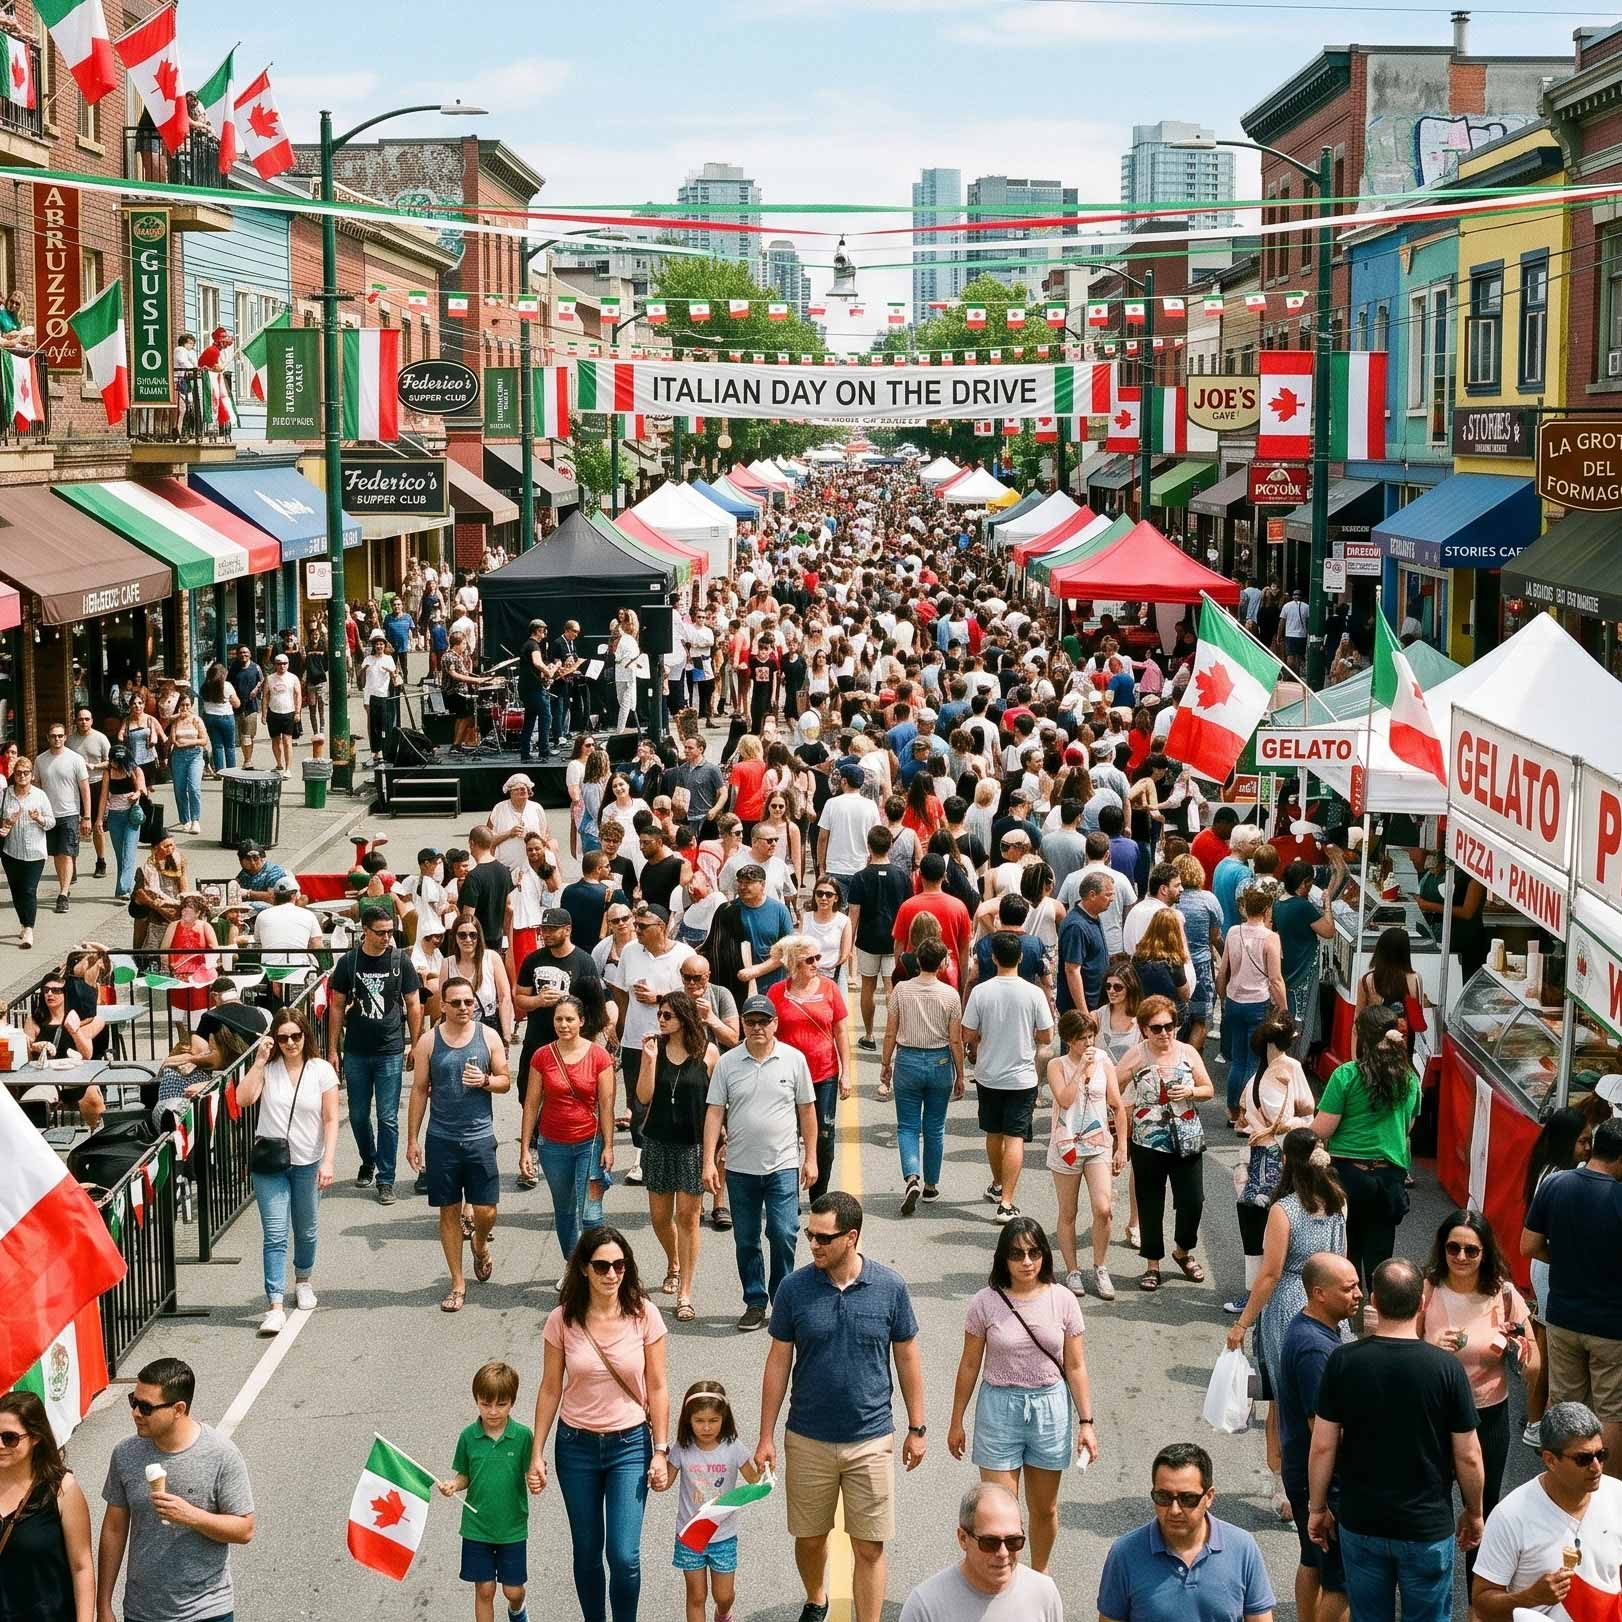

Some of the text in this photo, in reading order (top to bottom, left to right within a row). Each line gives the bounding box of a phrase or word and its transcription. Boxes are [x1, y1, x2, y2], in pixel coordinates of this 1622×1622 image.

[44, 187, 68, 338] ABRUZZO
[140, 249, 162, 371] GUSTO
[408, 394, 468, 402] SUPPER CLUB
[653, 376, 1037, 406] ITALIAN DAY ON THE DRIVE
[1193, 386, 1256, 410] JOE'S
[1549, 437, 1572, 458] LA
[1583, 460, 1616, 477] DEL
[356, 494, 428, 505] SUPPER CLUB
[1547, 475, 1622, 502] FORMAG
[1444, 545, 1497, 558] STORIES
[1499, 545, 1528, 558] CAF
[121, 582, 140, 606] CAFE
[1261, 738, 1352, 760] GELATO
[1456, 730, 1561, 843] GELATO
[1596, 789, 1622, 897] P
[1455, 829, 1561, 931] PIZZA PANINI
